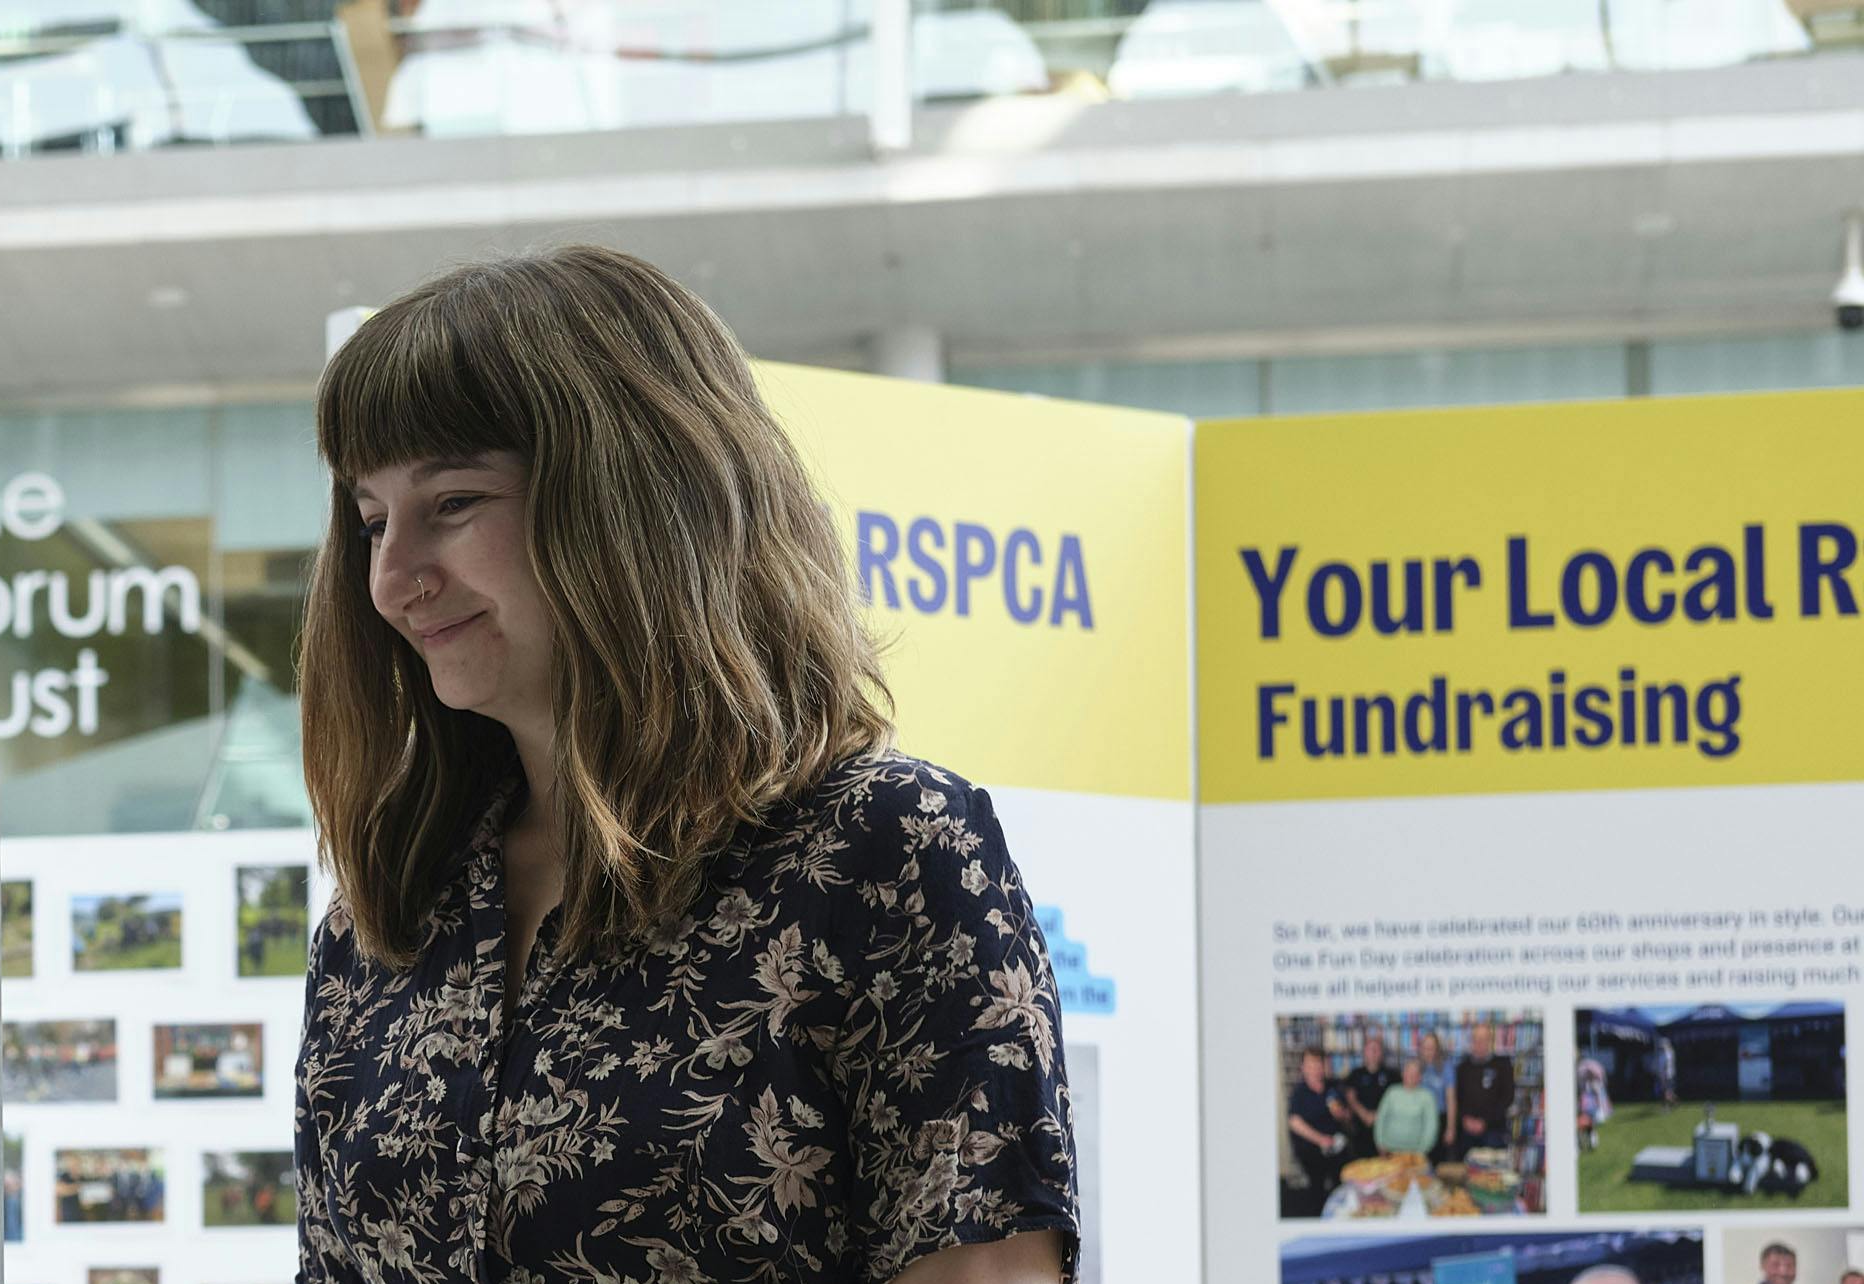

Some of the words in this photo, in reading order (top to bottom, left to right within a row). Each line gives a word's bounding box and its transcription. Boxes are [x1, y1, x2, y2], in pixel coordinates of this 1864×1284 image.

[857, 510, 1094, 630] RSPCA
[1238, 545, 1482, 640] Your
[1507, 522, 1774, 630] Local
[1798, 521, 1864, 618] R
[1256, 667, 1745, 760] Fundraising
